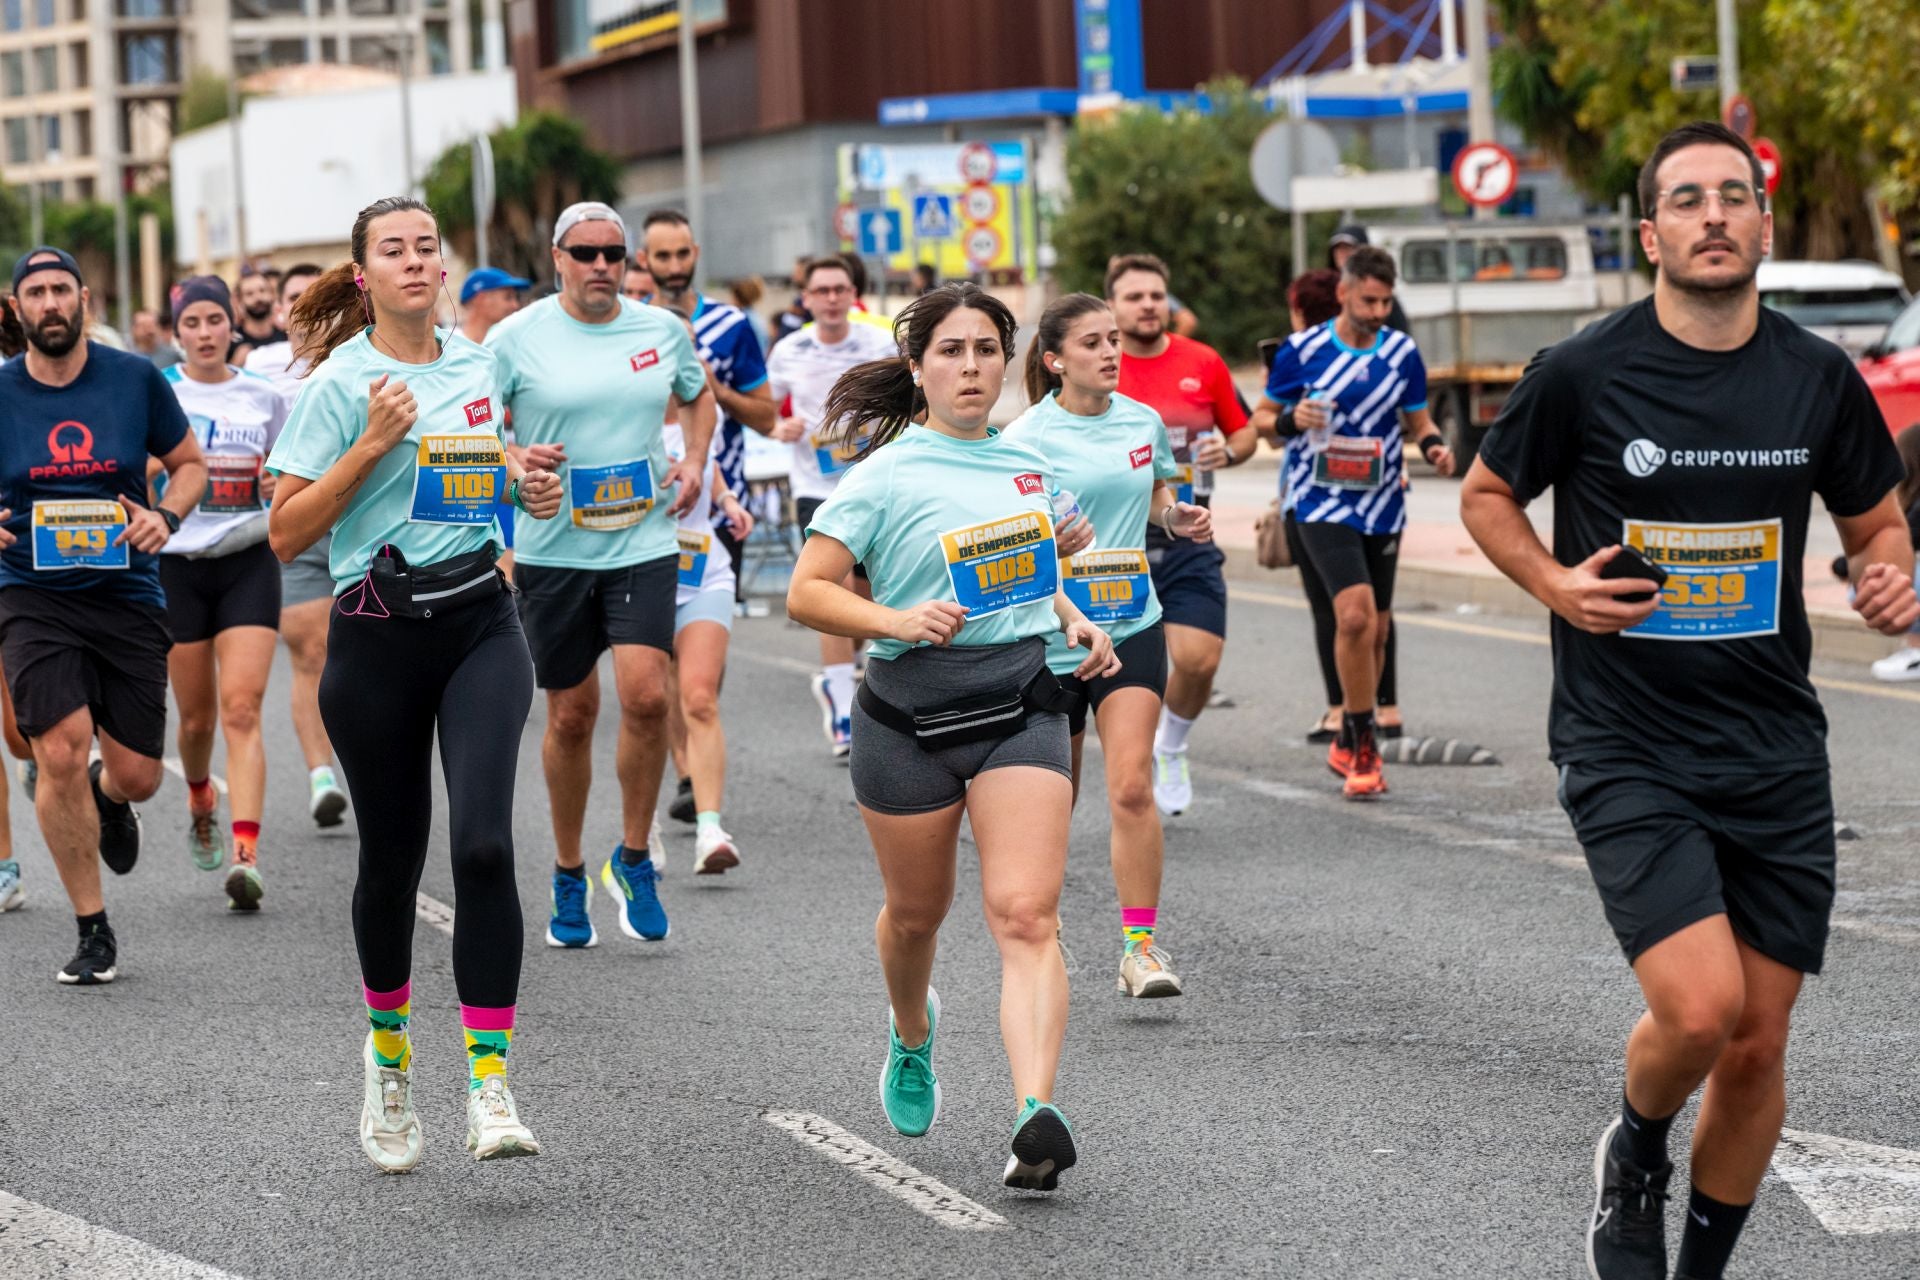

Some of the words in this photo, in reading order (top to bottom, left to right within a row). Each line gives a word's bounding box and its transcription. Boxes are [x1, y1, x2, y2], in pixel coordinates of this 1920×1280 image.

[467, 403, 488, 421] Tana
[427, 439, 443, 452] VI
[445, 439, 500, 452] CARRERA
[429, 453, 445, 464] DE
[446, 453, 500, 464] EMPRESAS
[1131, 450, 1150, 466] Tana
[1671, 448, 1810, 466] GRUPOVIHOTEC
[29, 459, 117, 479] PRAMAC
[442, 473, 495, 499] 1109
[57, 504, 117, 516] CARRERA
[58, 514, 116, 523] EMPRESAS
[55, 529, 107, 550] 943
[953, 531, 972, 548] VI
[973, 515, 1041, 543] CARRERA
[1641, 529, 1664, 547] VI
[1666, 529, 1767, 549] CARRERA
[959, 545, 976, 559] DE
[977, 528, 1042, 554] EMPRESAS
[1085, 552, 1141, 566] CARRERA
[1644, 548, 1665, 561] DE
[1668, 546, 1763, 562] EMPRESAS
[975, 552, 1036, 590] 1108
[1071, 566, 1086, 576] DE
[1087, 563, 1141, 574] EMPRESAS
[1088, 580, 1133, 602] 1110
[1663, 573, 1746, 605] 539
